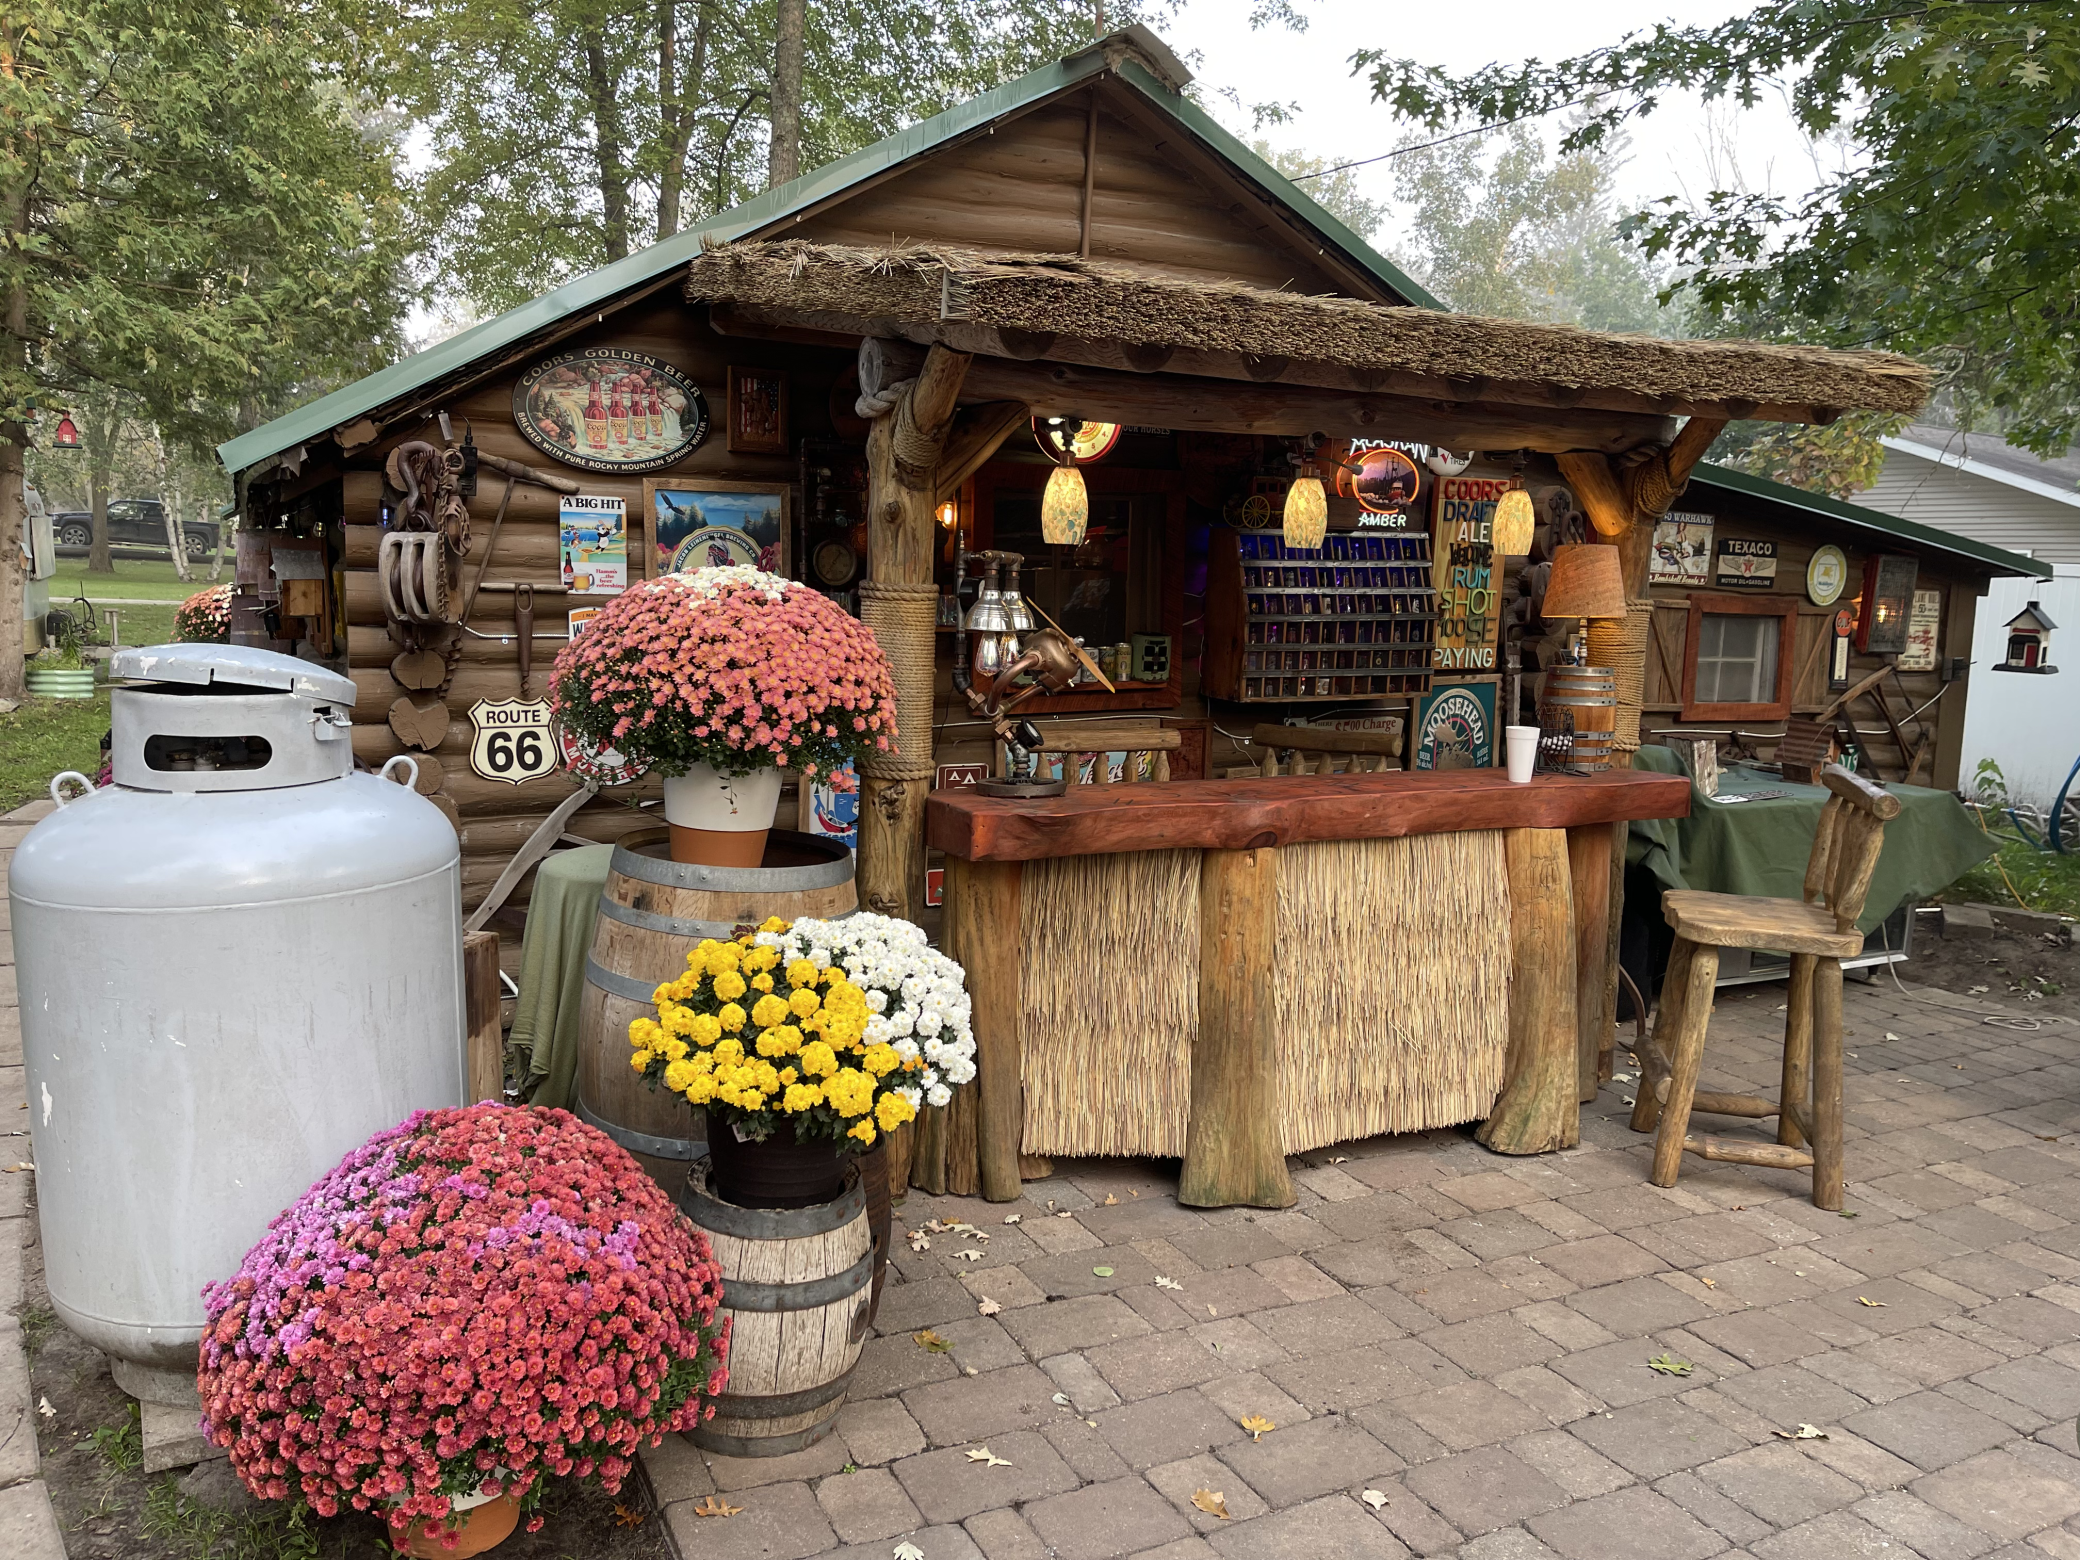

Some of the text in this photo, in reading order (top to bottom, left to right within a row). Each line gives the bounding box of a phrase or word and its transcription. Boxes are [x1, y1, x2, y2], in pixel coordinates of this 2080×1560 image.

[522, 349, 700, 398] COORS GOLDEN BEER
[517, 411, 707, 471] BREWED WITH PURE ROCKY MOUNTAIN SPRING WATER
[1444, 479, 1508, 501] COORS
[563, 497, 622, 510] A BIG HIT
[1443, 500, 1498, 522] DRAF
[1358, 512, 1407, 527] AMBER
[1673, 513, 1714, 525] WARHAWK
[1457, 522, 1491, 543] ALE
[1728, 540, 1773, 555] TEXACO
[1453, 568, 1490, 589] RUM
[1441, 589, 1498, 616] SHOT
[486, 709, 541, 724] ROUTE
[1362, 718, 1397, 732] Charge
[1423, 697, 1484, 747] MOOSEHEAD
[487, 730, 543, 772] 66
